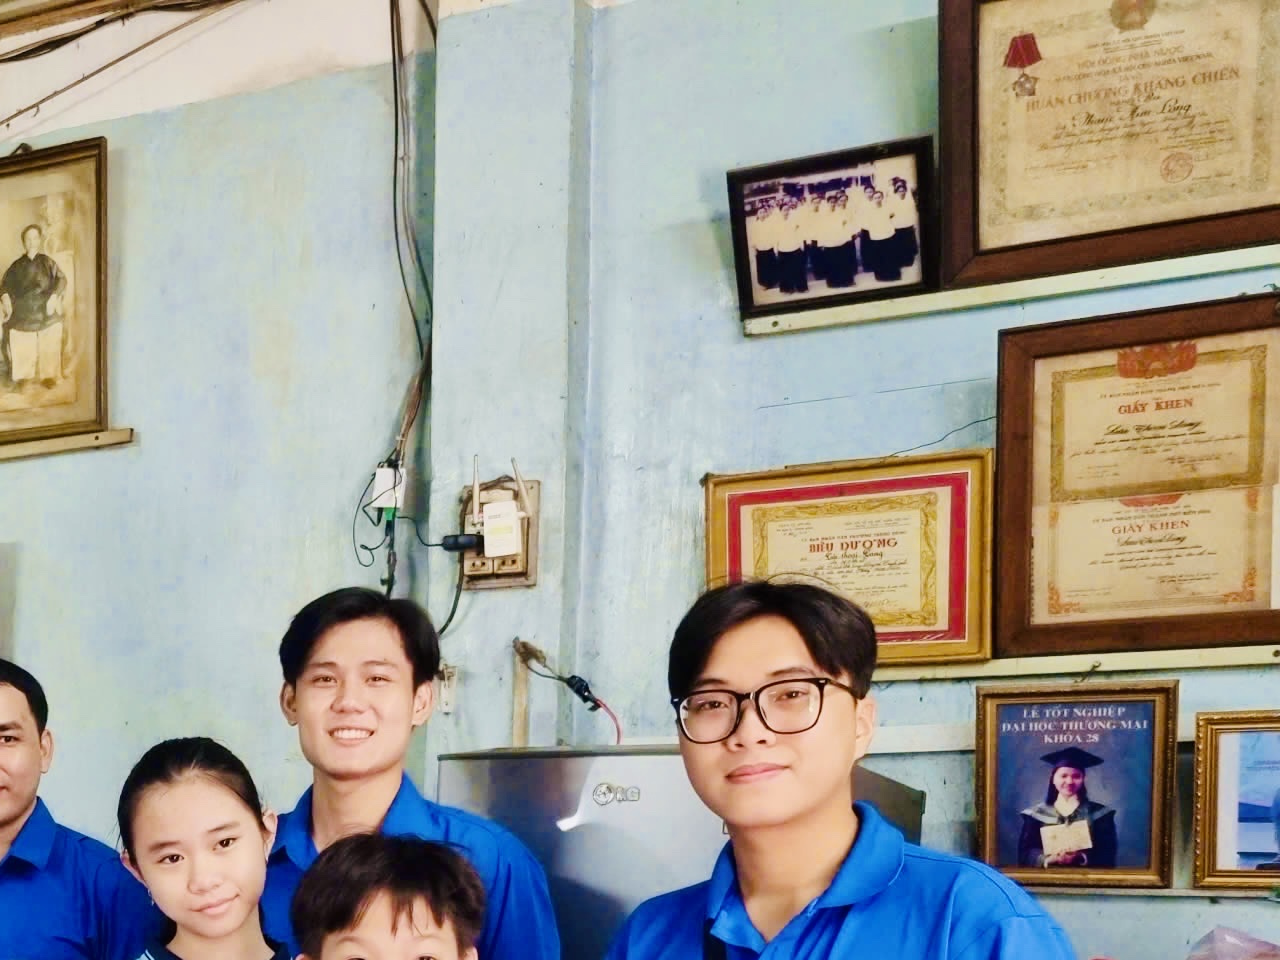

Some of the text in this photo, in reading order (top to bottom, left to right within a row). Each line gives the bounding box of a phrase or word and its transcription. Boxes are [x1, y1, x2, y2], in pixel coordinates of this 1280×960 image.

[1154, 398, 1194, 411] KHEN
[1150, 519, 1190, 532] KHEN
[1045, 704, 1070, 718] TỐT
[1073, 704, 1126, 718] NGHIỆP
